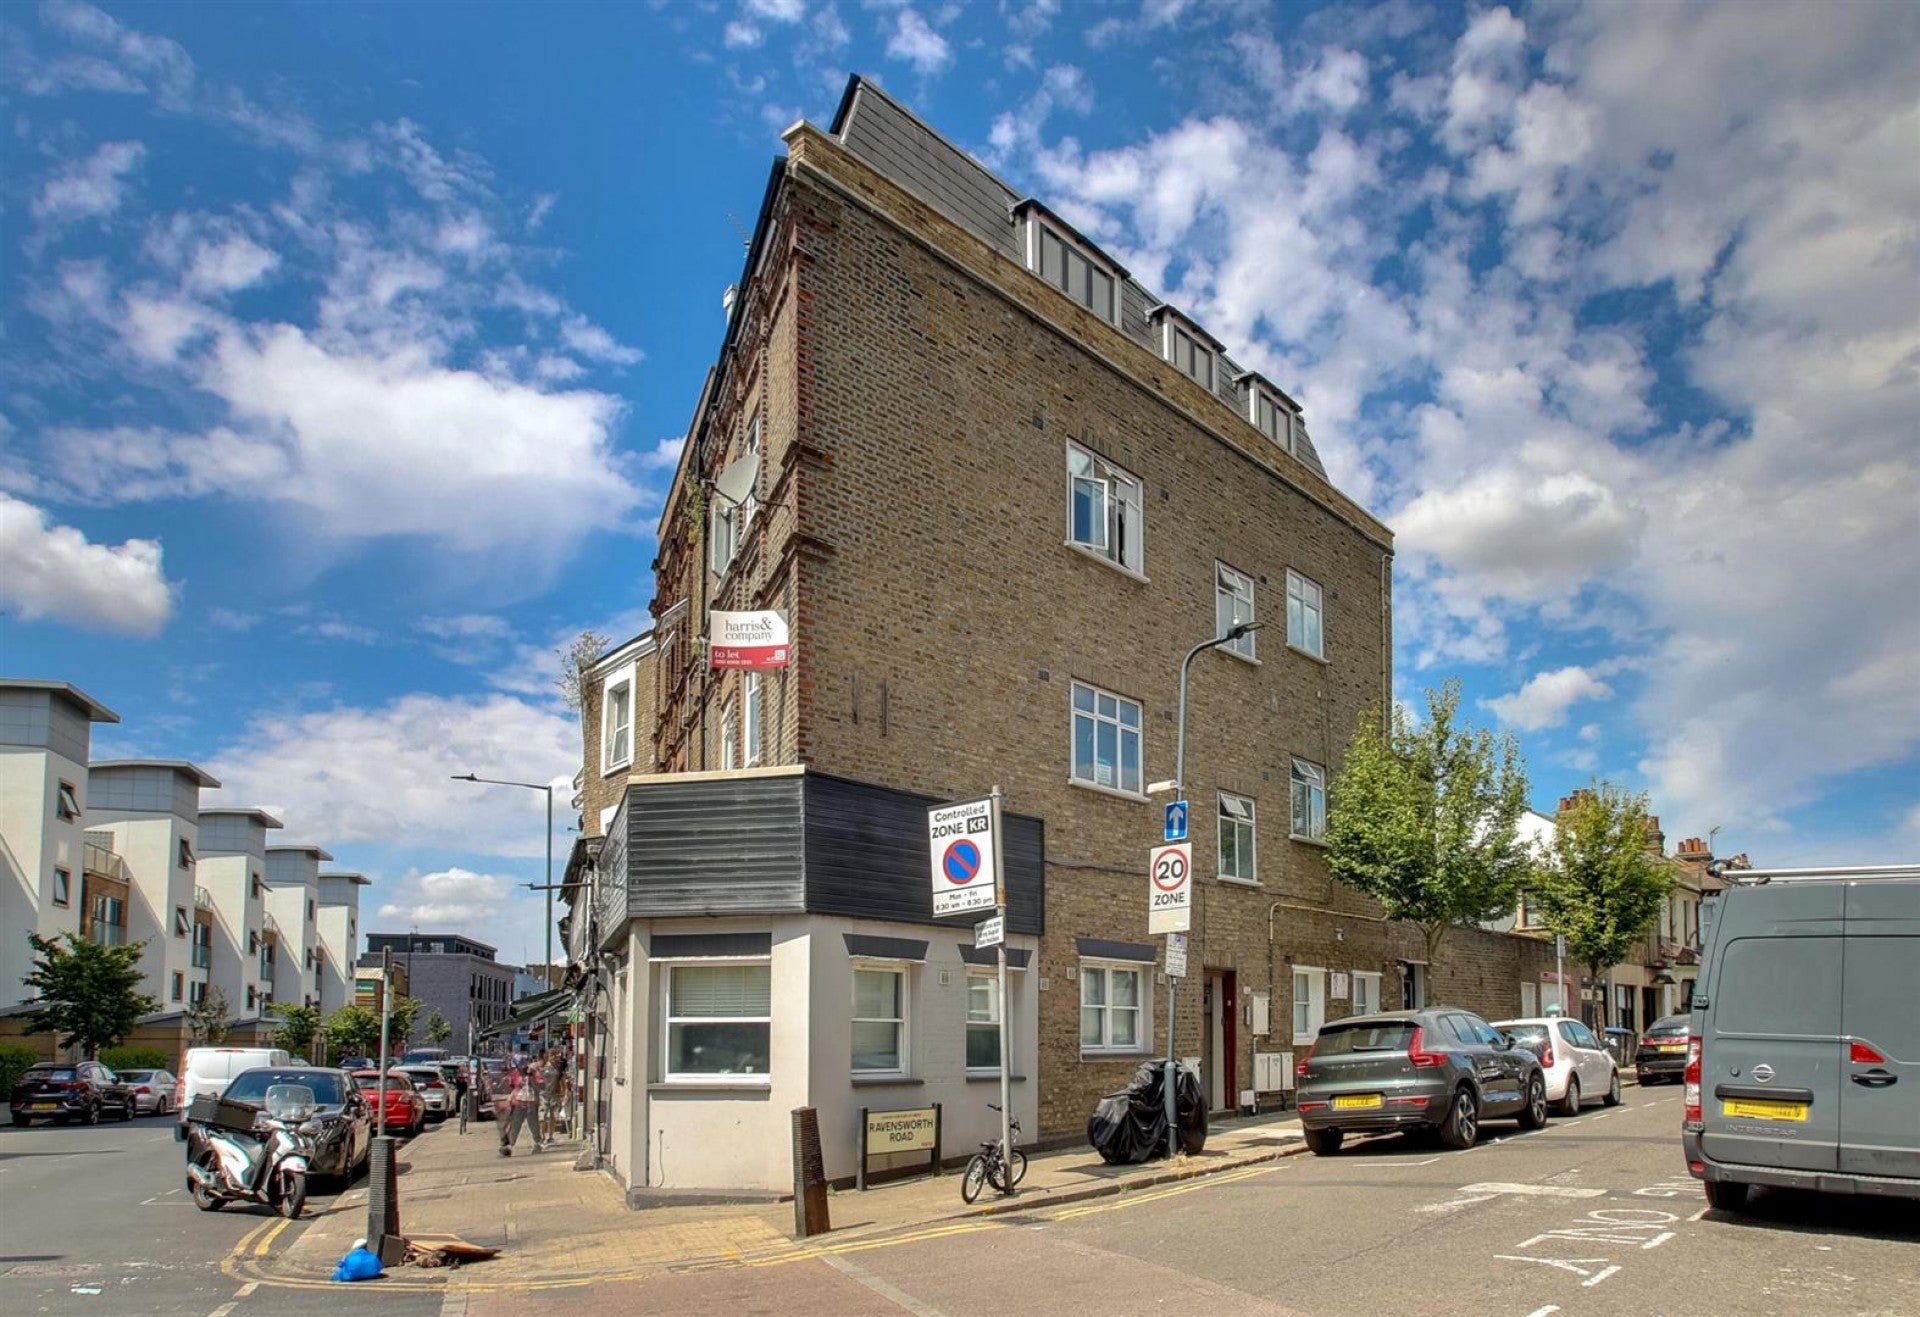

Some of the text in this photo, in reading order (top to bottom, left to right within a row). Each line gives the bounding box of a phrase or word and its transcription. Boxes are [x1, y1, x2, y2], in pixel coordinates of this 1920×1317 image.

[725, 631, 772, 642] company
[714, 650, 740, 659] to let
[934, 804, 985, 822] Controlled
[931, 817, 987, 839] ZONE KR
[1157, 859, 1184, 880] 20
[1154, 892, 1186, 906] ZONE
[869, 1119, 934, 1133] RAVENSWORTH
[889, 1132, 914, 1142] ROAD
